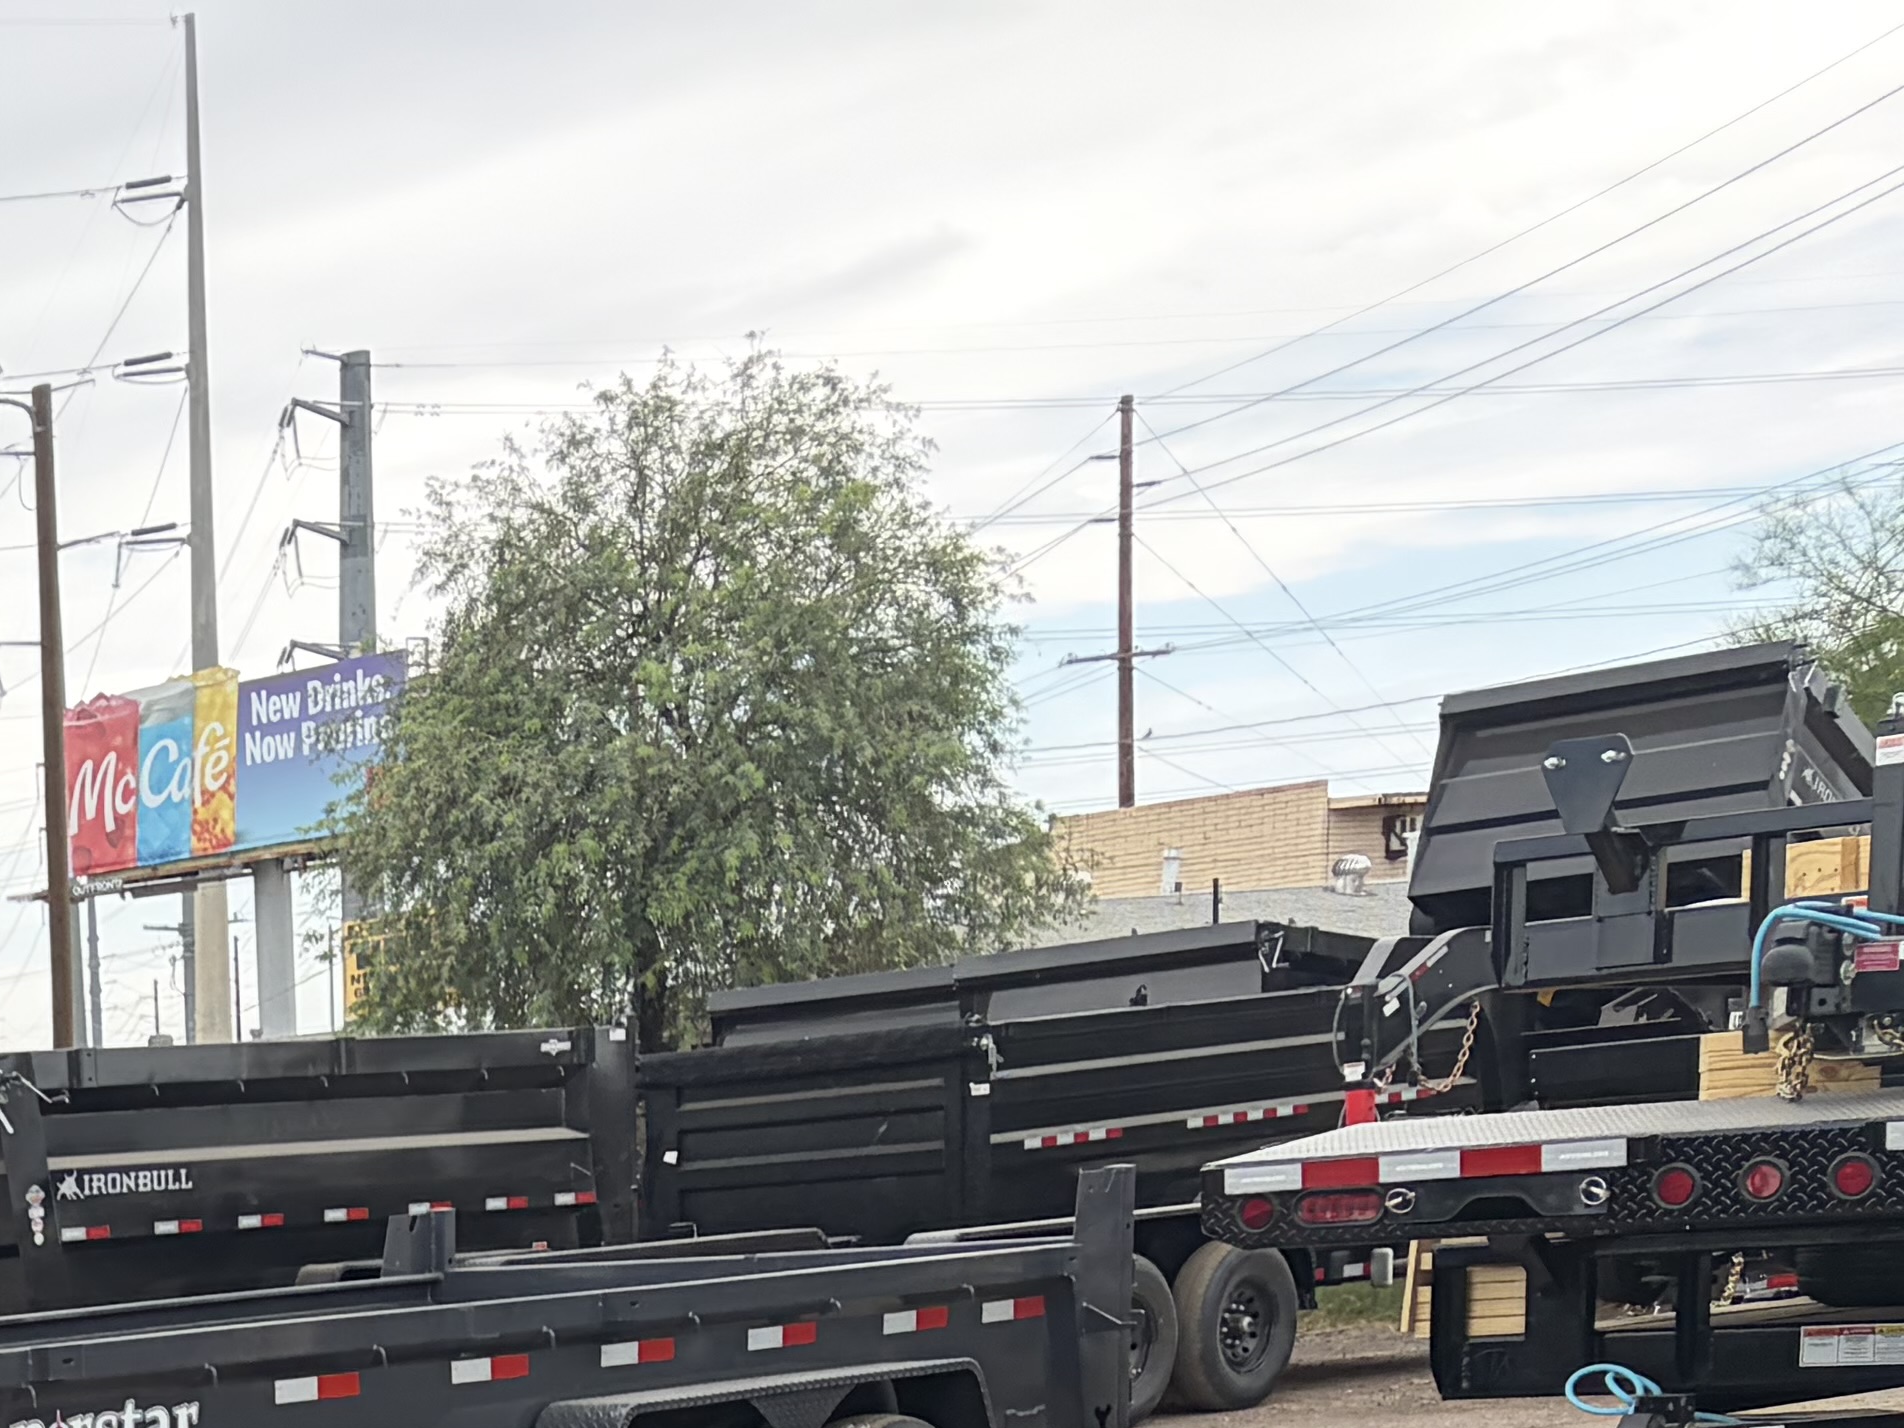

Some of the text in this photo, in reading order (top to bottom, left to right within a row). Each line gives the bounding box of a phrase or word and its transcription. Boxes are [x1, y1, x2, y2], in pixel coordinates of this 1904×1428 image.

[250, 689, 301, 726] New
[244, 730, 295, 766] Now
[69, 721, 231, 837] McCafé
[83, 1169, 193, 1196] IRONBULL
